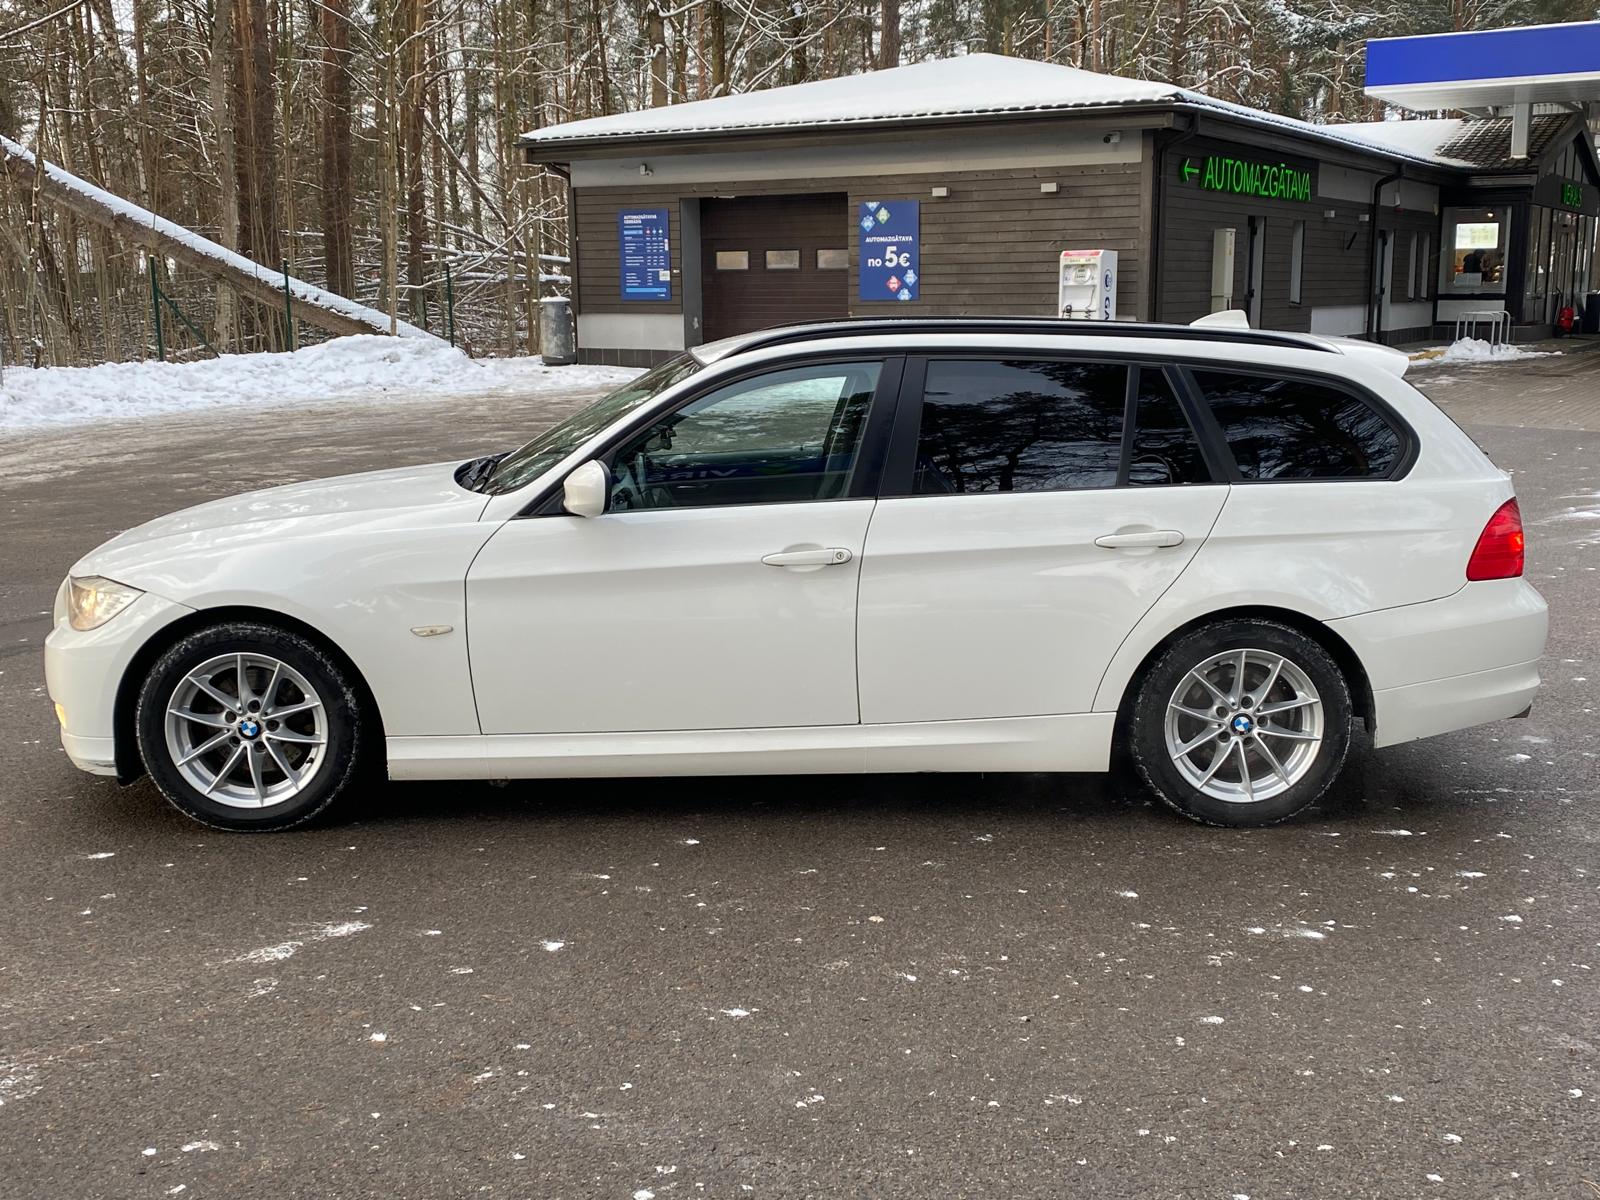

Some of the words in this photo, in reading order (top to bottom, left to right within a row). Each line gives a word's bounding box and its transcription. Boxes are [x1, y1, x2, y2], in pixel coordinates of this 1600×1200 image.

[1203, 156, 1312, 201] AUTOMAZGĀTAVA
[865, 234, 913, 243] AUTOMAZGĀTAVA
[867, 258, 882, 267] no
[884, 245, 911, 268] 5€
